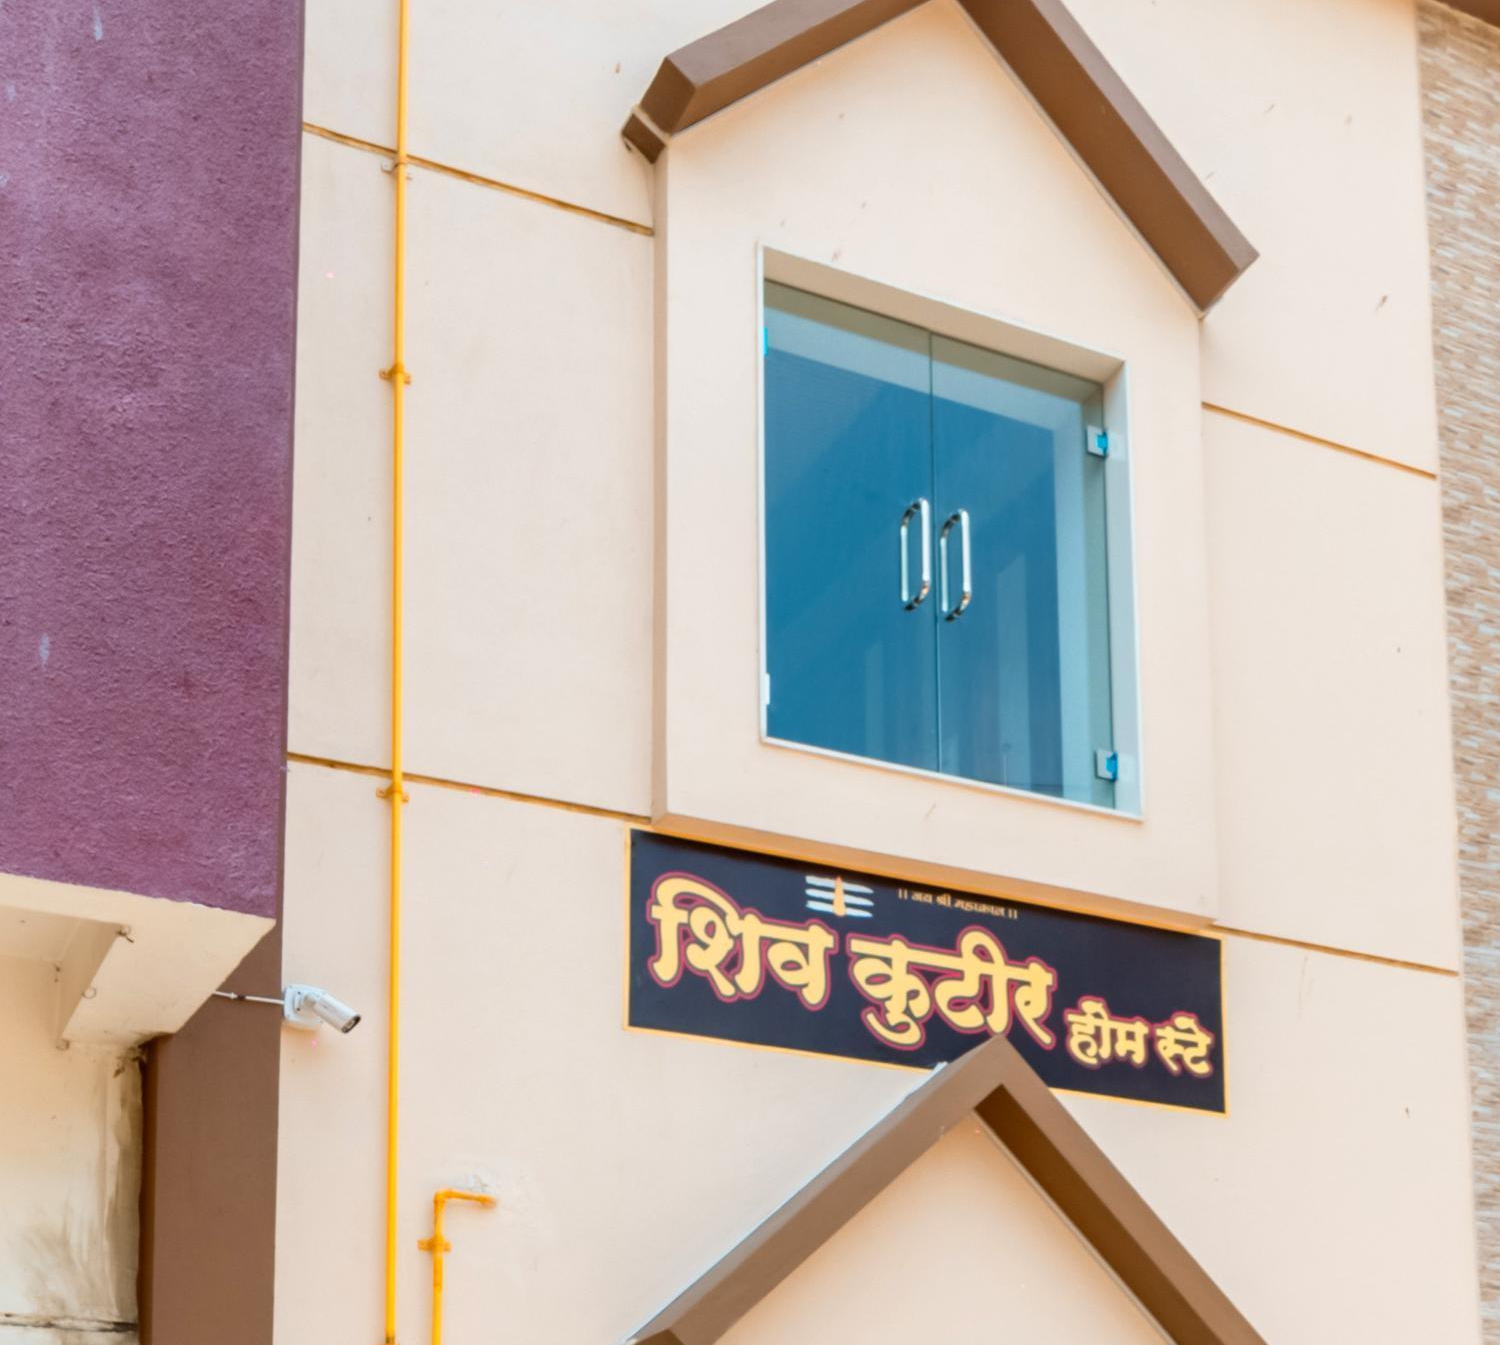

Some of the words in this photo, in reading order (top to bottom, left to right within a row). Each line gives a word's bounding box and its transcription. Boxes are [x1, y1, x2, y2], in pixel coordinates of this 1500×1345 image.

[648, 873, 837, 1009] शिव
[848, 926, 1056, 1050] कुटीर
[1064, 997, 1150, 1068] होम
[1153, 1011, 1213, 1077] स्टे
